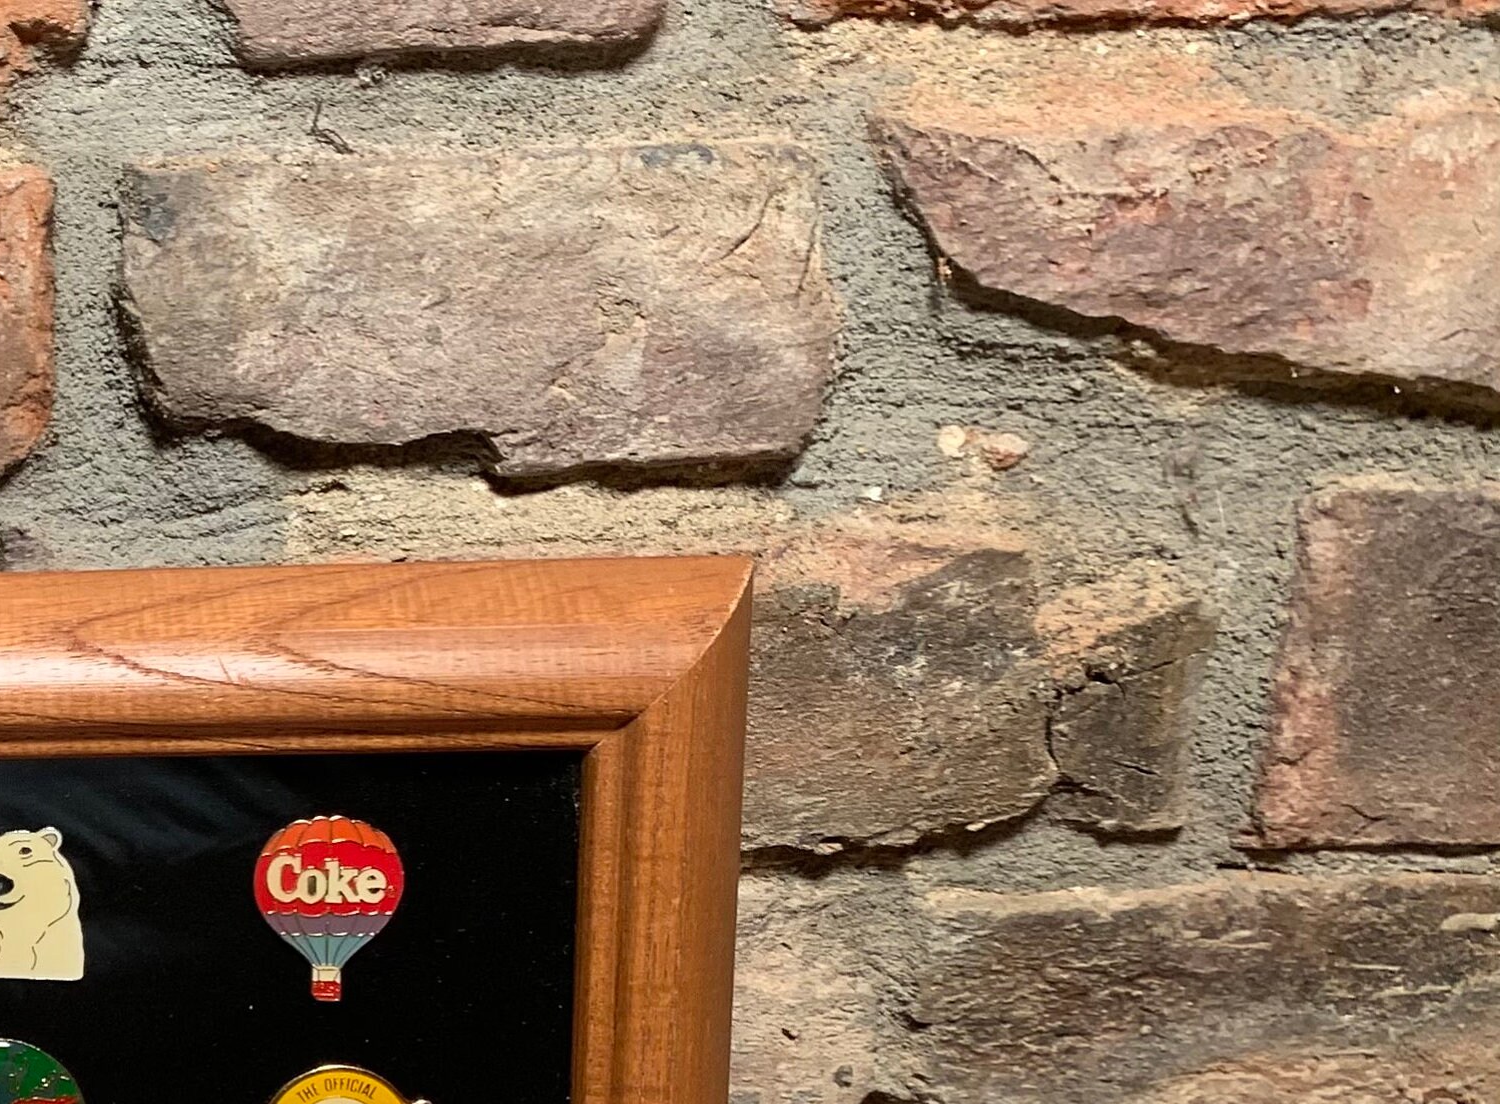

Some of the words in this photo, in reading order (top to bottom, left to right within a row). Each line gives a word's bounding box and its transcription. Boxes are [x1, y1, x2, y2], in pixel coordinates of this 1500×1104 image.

[267, 853, 387, 904] Coke
[296, 1084, 319, 1103] THE
[324, 1078, 377, 1099] OFFICIAL
